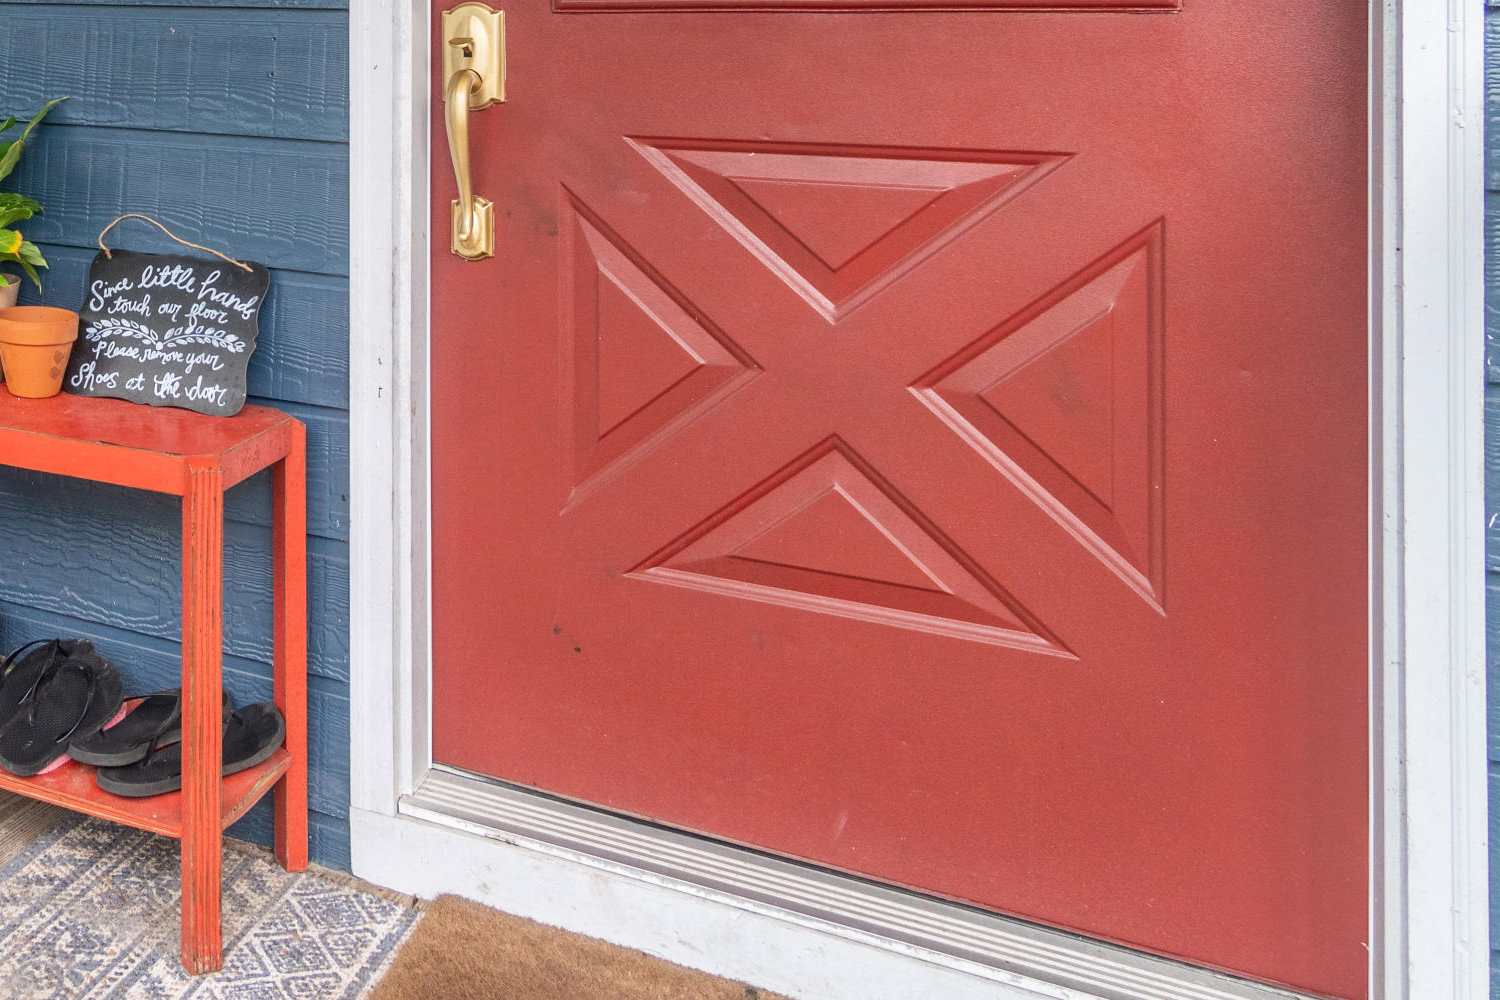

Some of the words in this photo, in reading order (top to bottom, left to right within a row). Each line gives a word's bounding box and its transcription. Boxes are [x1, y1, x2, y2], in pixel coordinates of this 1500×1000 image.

[89, 277, 133, 312] Since
[137, 264, 196, 293] little
[197, 269, 260, 321] hands
[107, 293, 152, 317] touch
[157, 301, 183, 322] our
[184, 300, 229, 328] floor
[91, 340, 140, 360] Please
[138, 348, 185, 365] remove
[184, 351, 225, 375] your
[70, 360, 120, 392] Shoes
[125, 372, 146, 391] at
[184, 374, 228, 407] door
